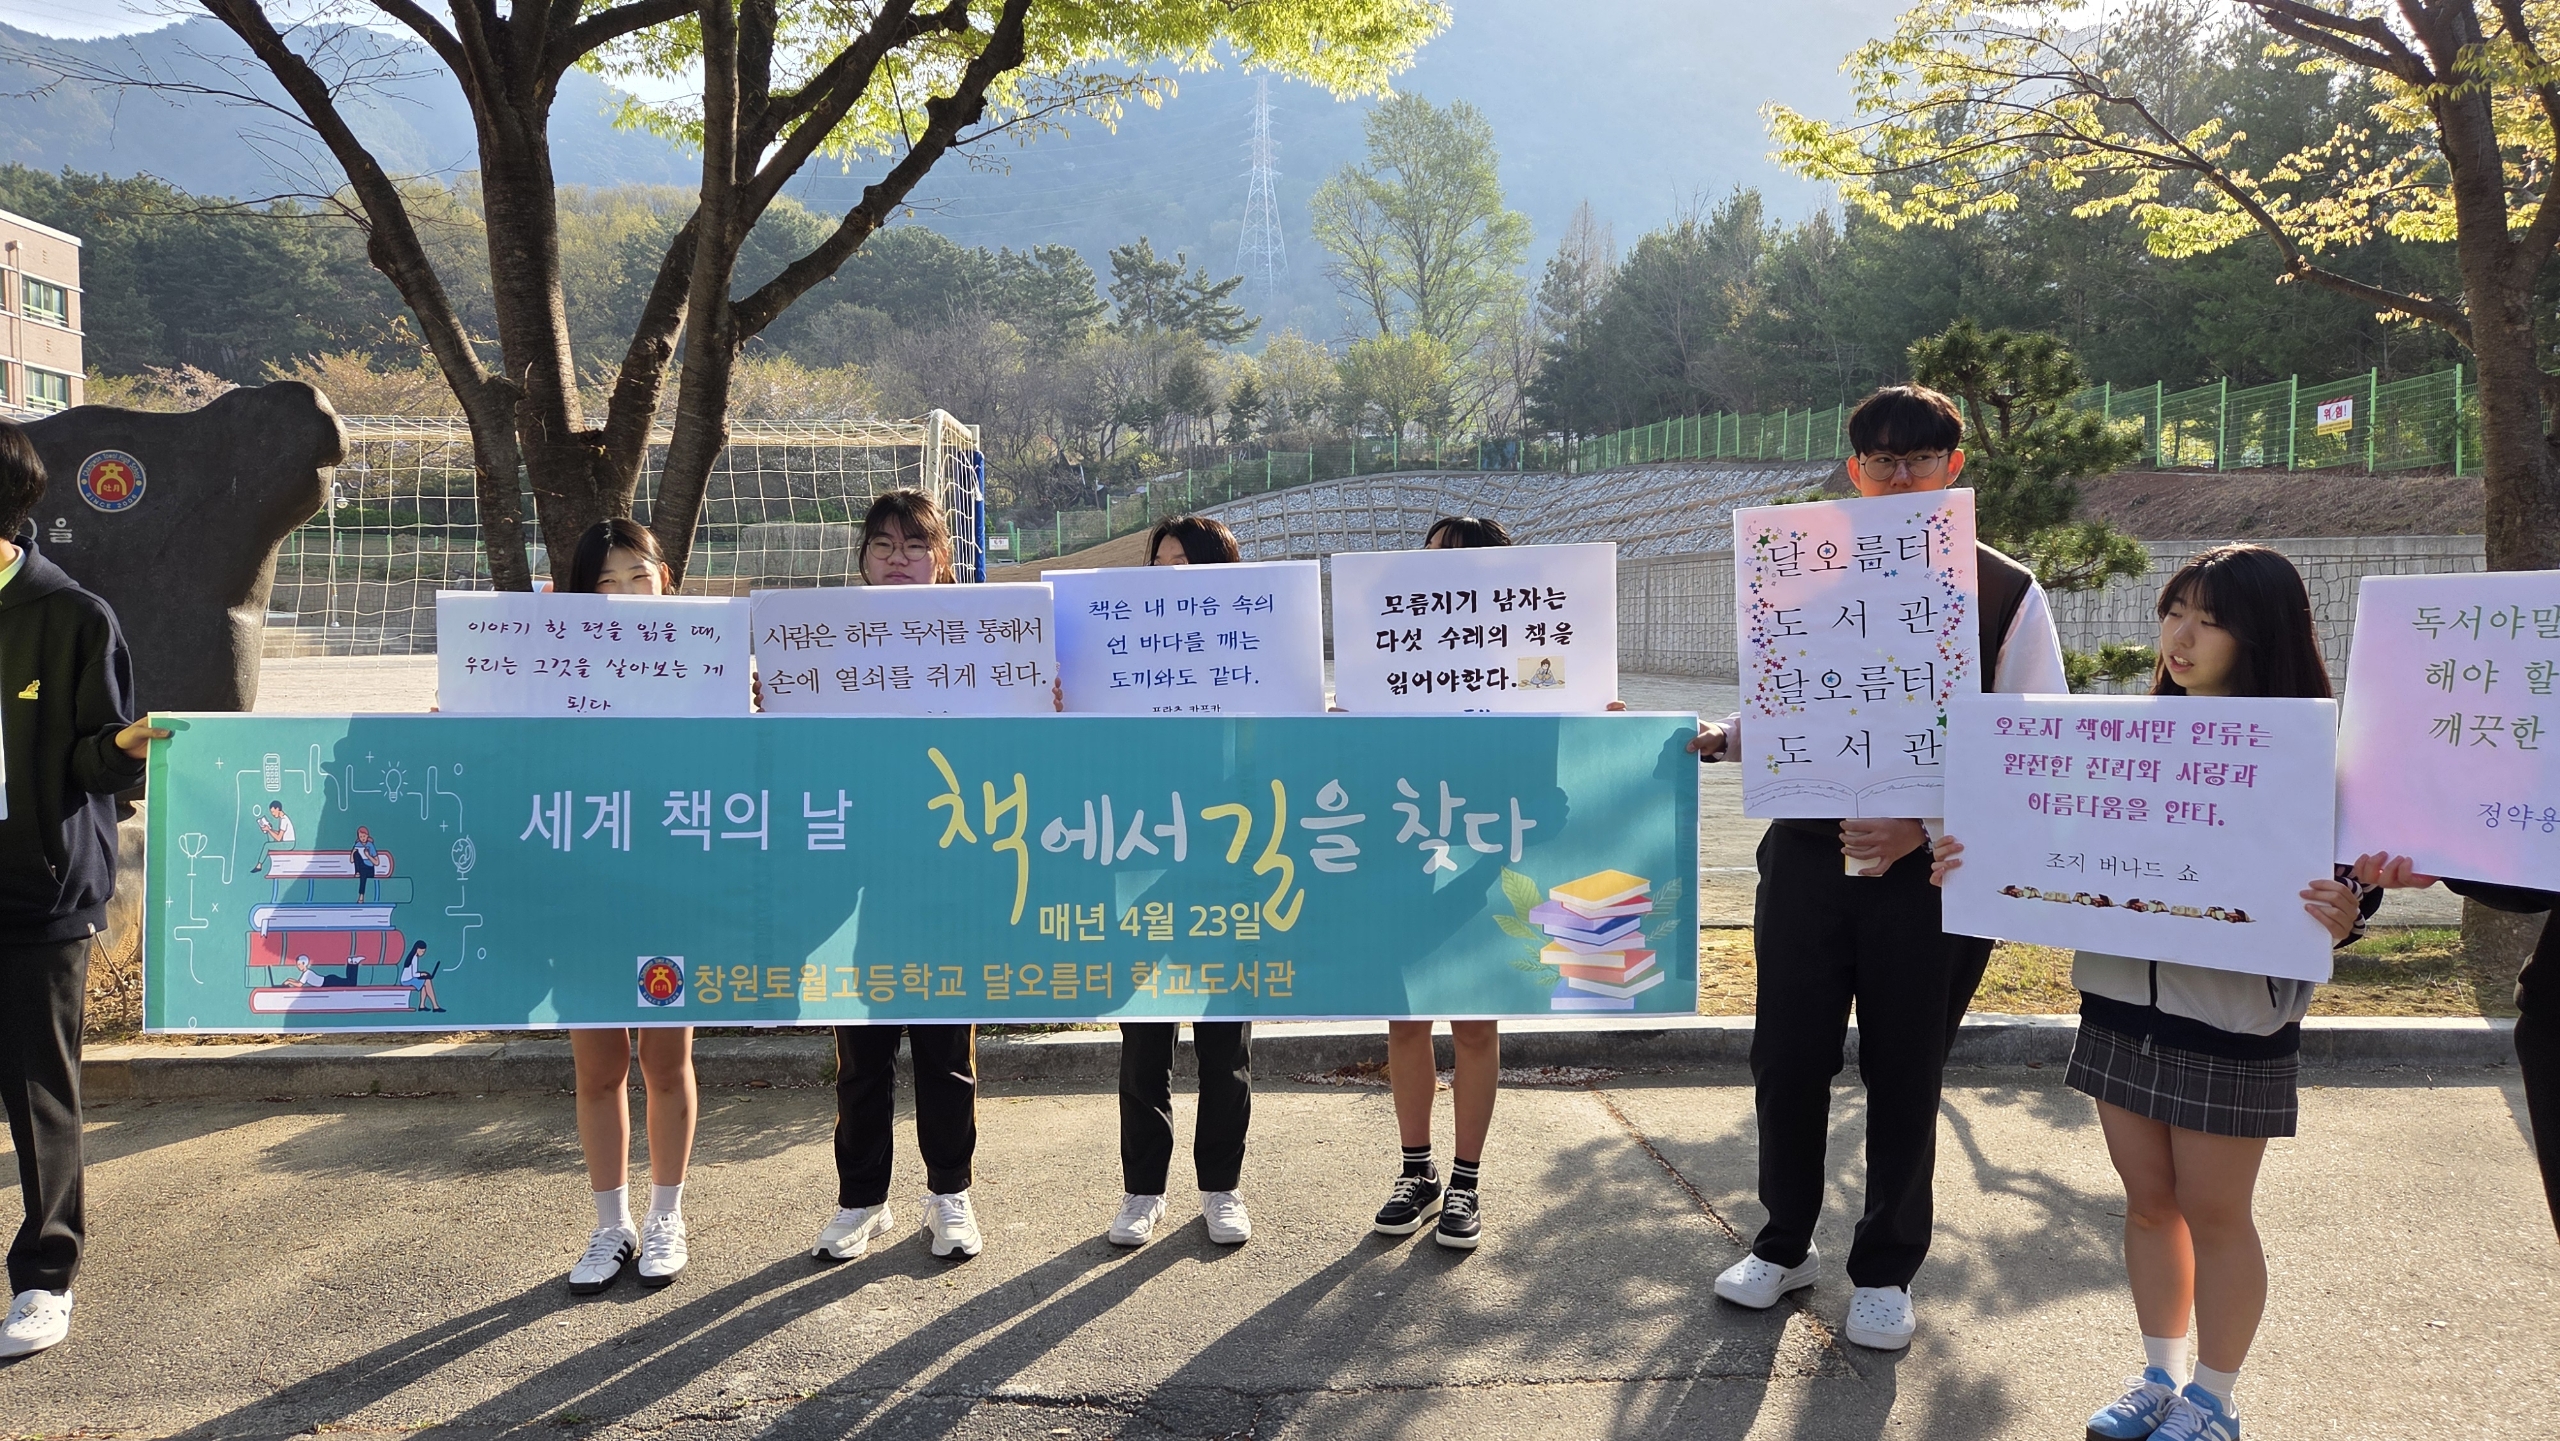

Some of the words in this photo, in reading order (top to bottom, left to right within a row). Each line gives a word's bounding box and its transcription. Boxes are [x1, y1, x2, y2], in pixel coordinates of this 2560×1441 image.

[86, 492, 111, 508] SINCE
[117, 494, 137, 508] 2006
[1768, 529, 1933, 578] 달오름터
[1088, 599, 1133, 621] 책은
[1145, 598, 1165, 618] 내
[1177, 596, 1221, 617] 마음
[1232, 593, 1273, 616] 속의
[1380, 589, 1477, 616] 모름지기
[1493, 586, 1567, 613] 남자는
[468, 621, 530, 635] 이야기
[545, 619, 567, 639] 한
[581, 620, 623, 641] 편을
[637, 621, 677, 642] 읽을
[691, 624, 721, 643] 때,
[763, 623, 837, 651] 사람은
[844, 621, 893, 648] 하루
[900, 619, 969, 646] 독서를
[976, 617, 1042, 644] 통해서
[1107, 634, 1128, 655] 언
[1140, 631, 1205, 654] 바다를
[1216, 630, 1261, 650] 깨는
[1376, 627, 1423, 653] 다섯
[1437, 623, 1508, 650] 수레의
[1524, 621, 1574, 646] 책을
[465, 656, 518, 675] 우리는
[533, 657, 591, 678] 그것을
[605, 658, 688, 678] 살아보는
[703, 664, 724, 676] 게
[767, 667, 819, 695] 손에
[836, 665, 914, 692] 열쇠를
[926, 663, 976, 689] 쥐게
[990, 661, 1047, 687] 된다.
[1109, 668, 1197, 689] 도끼와도
[1209, 665, 1260, 686] 같다.
[1386, 667, 1517, 695] 읽어야한다.
[1773, 661, 1935, 705] 달오름터
[2424, 658, 2500, 695] 해야
[2524, 660, 2560, 695] 할
[1993, 716, 2063, 740] 오로지
[2075, 718, 2176, 745] 책에서만
[2191, 721, 2274, 749] 인류는
[2429, 712, 2545, 750] 깨끗한
[2003, 752, 2073, 780] 완전한
[2085, 756, 2162, 784] 진리와
[2175, 760, 2259, 789] 사랑과
[519, 789, 632, 853] 세계
[662, 789, 769, 852] 책의
[803, 789, 853, 850] 날
[2028, 792, 2150, 823] 아름다움을
[2164, 799, 2225, 827] 안다.
[2477, 801, 2560, 833] 정약용
[927, 746, 1187, 927] 책에서
[1200, 779, 1366, 932] 길을
[1392, 778, 1537, 875] 찾다
[2046, 852, 2085, 874] 조지
[2100, 855, 2164, 880] 버나드
[2177, 864, 2200, 883] 쇼
[1039, 903, 1104, 942] 매년
[1119, 902, 1175, 941] 4월
[1189, 901, 1262, 940] 23일
[694, 963, 966, 1003] 창원토월고등학교
[983, 962, 1114, 1000] 달오름터
[1130, 961, 1296, 999] 학교도서관
